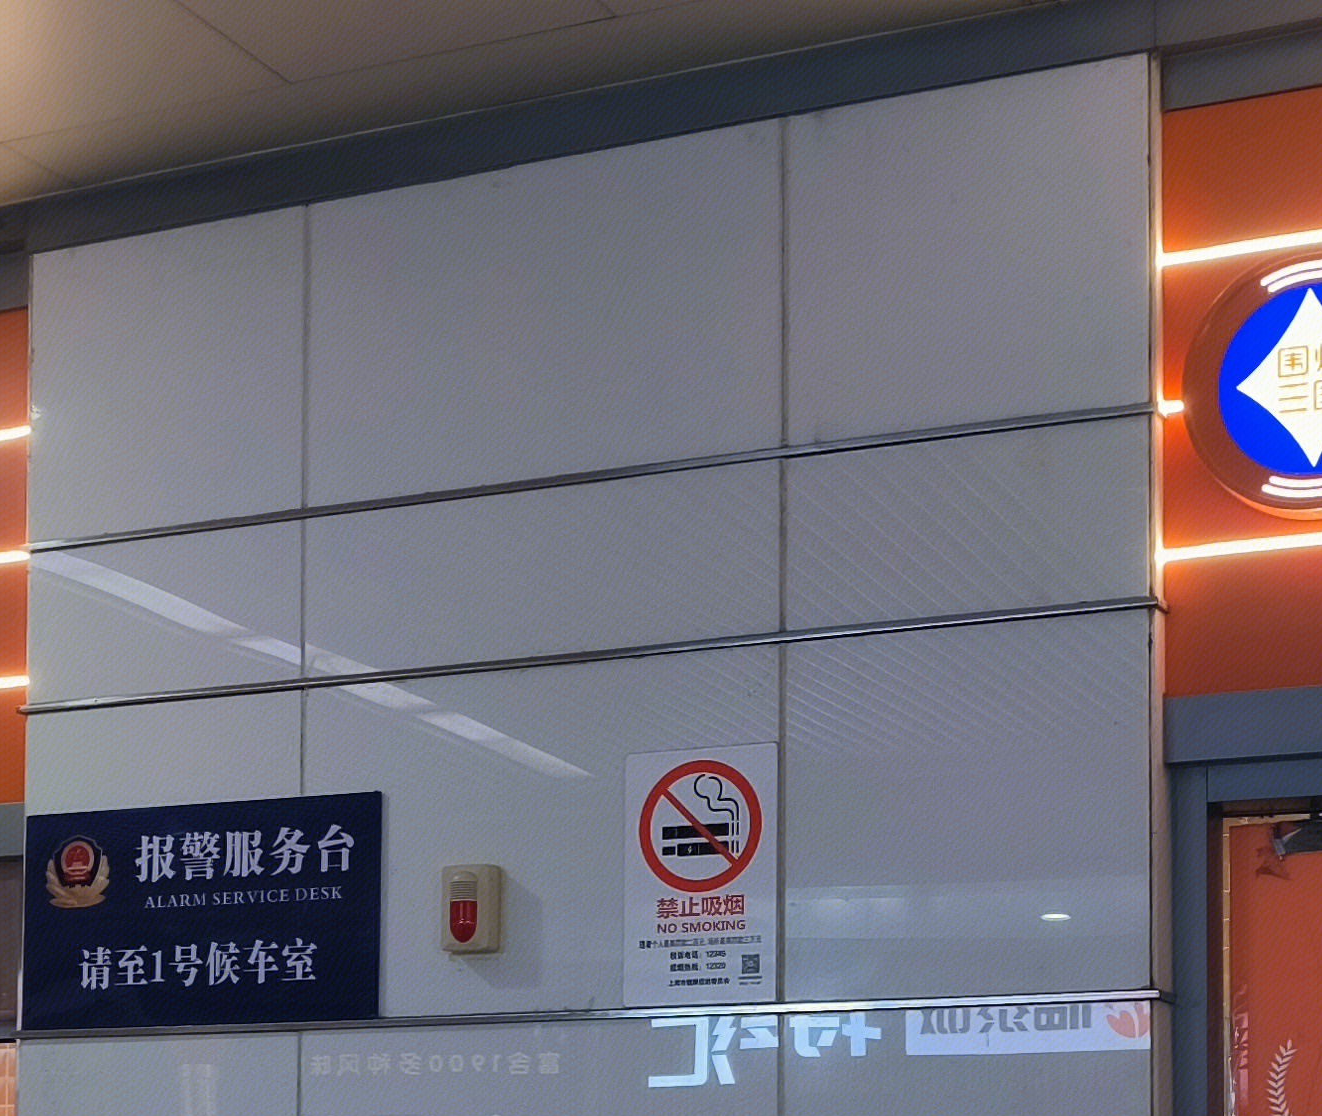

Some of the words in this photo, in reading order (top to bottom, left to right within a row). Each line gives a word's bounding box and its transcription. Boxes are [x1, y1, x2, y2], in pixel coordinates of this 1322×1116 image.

[135, 824, 355, 883] 报警服务台
[144, 893, 207, 909] ALARM
[212, 888, 290, 906] SERVICE
[295, 886, 343, 902] DESK
[656, 894, 745, 919] 禁止吸烟
[657, 922, 677, 934] NO
[681, 920, 746, 933] SMOKING
[78, 937, 317, 990] 请至1号候车室
